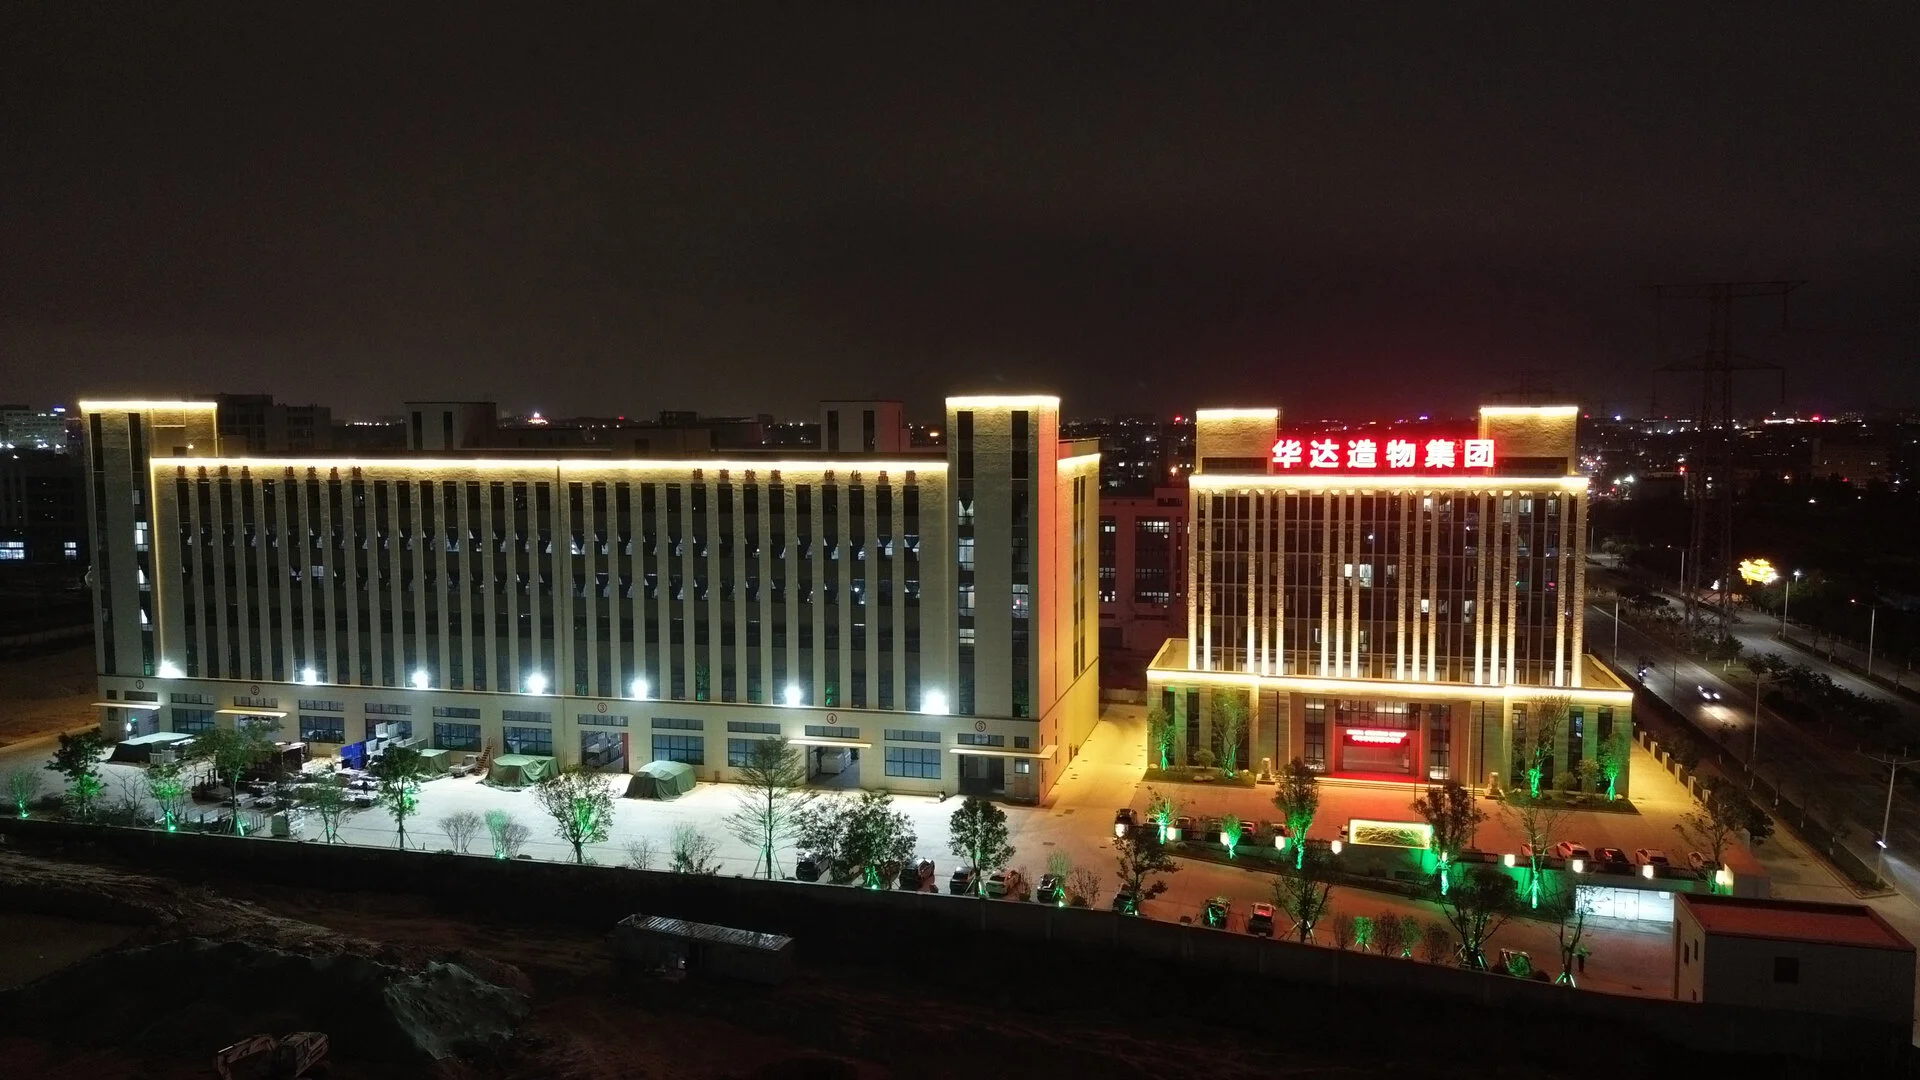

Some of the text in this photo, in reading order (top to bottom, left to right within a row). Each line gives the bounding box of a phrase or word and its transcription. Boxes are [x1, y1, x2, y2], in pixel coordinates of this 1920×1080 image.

[1272, 439, 1495, 469] 华达造物集团
[692, 468, 916, 482] 提高效率 优化品质
